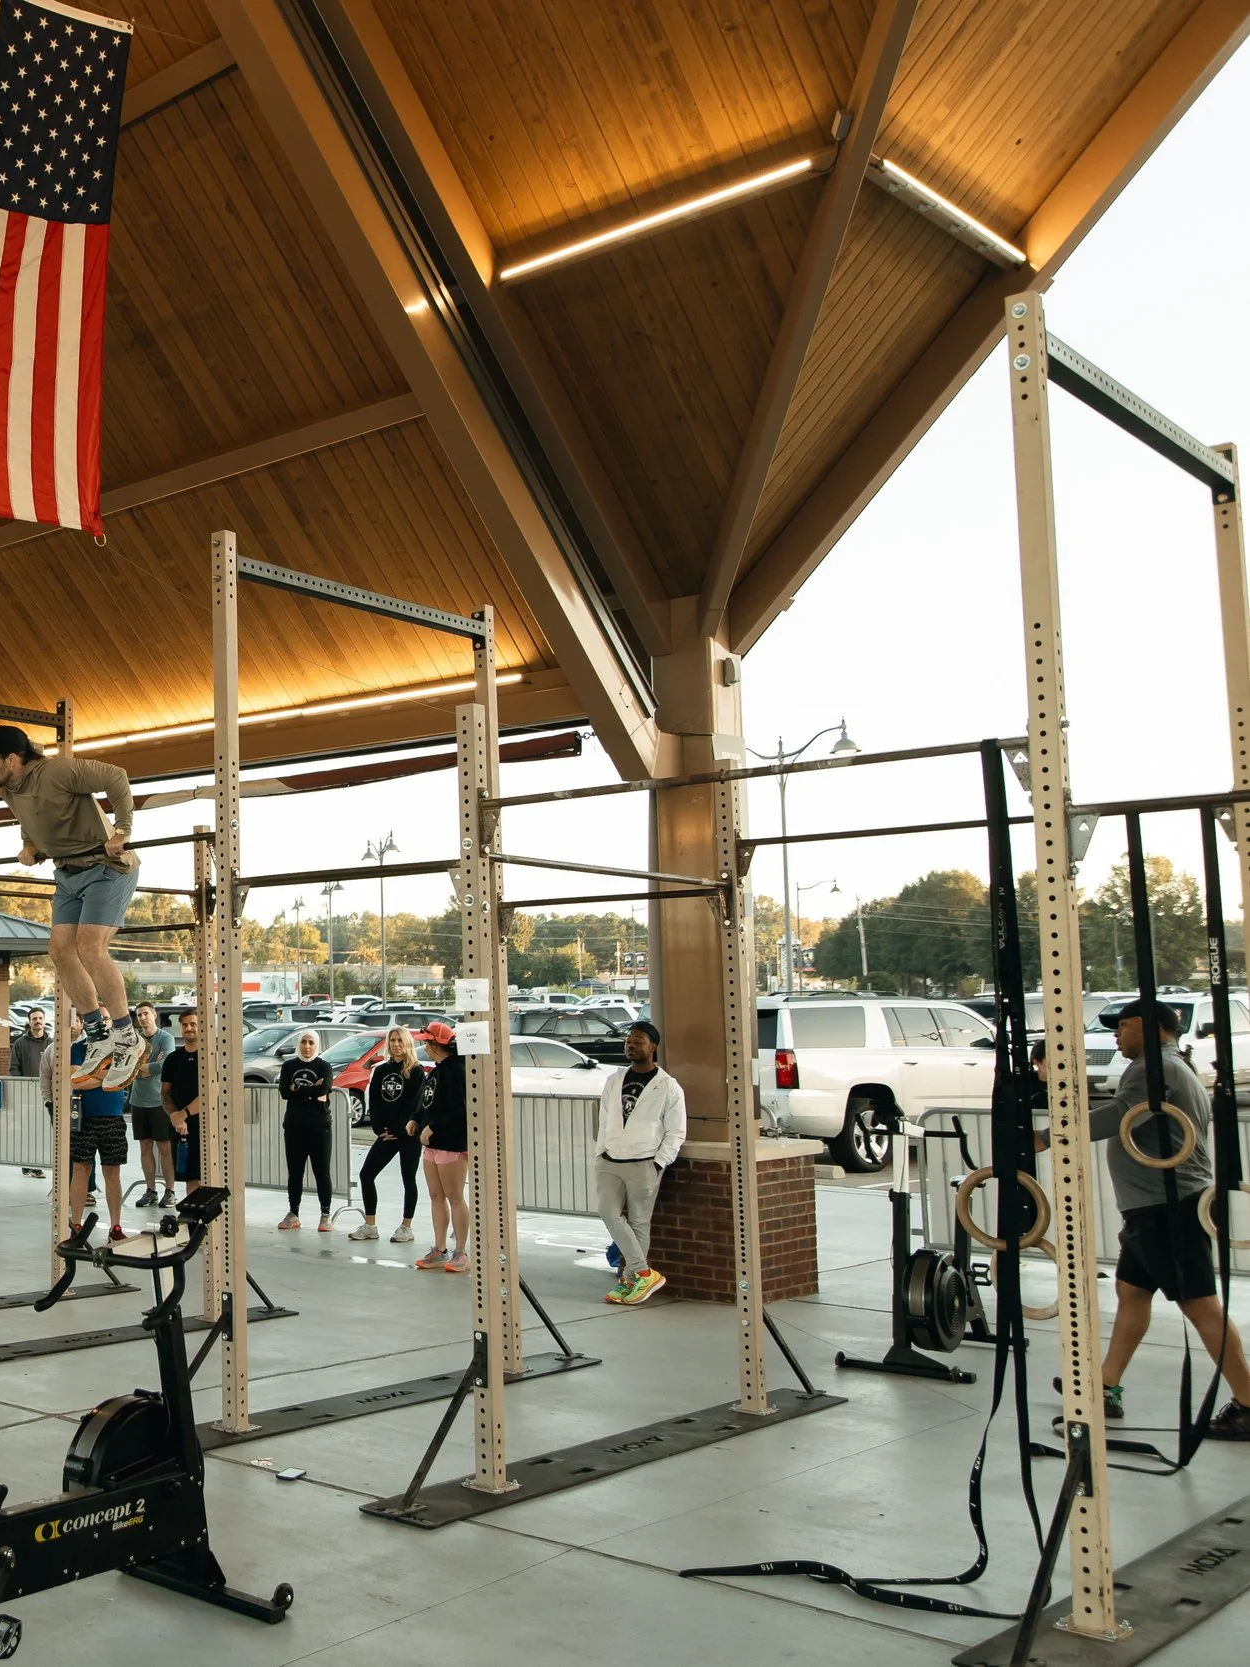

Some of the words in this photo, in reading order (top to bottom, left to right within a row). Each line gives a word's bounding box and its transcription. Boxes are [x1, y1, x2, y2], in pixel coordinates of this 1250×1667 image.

[1209, 937, 1221, 985] ROGUE
[62, 1502, 132, 1533] concept
[135, 1498, 146, 1513] 2
[112, 1515, 145, 1531] BikeERG
